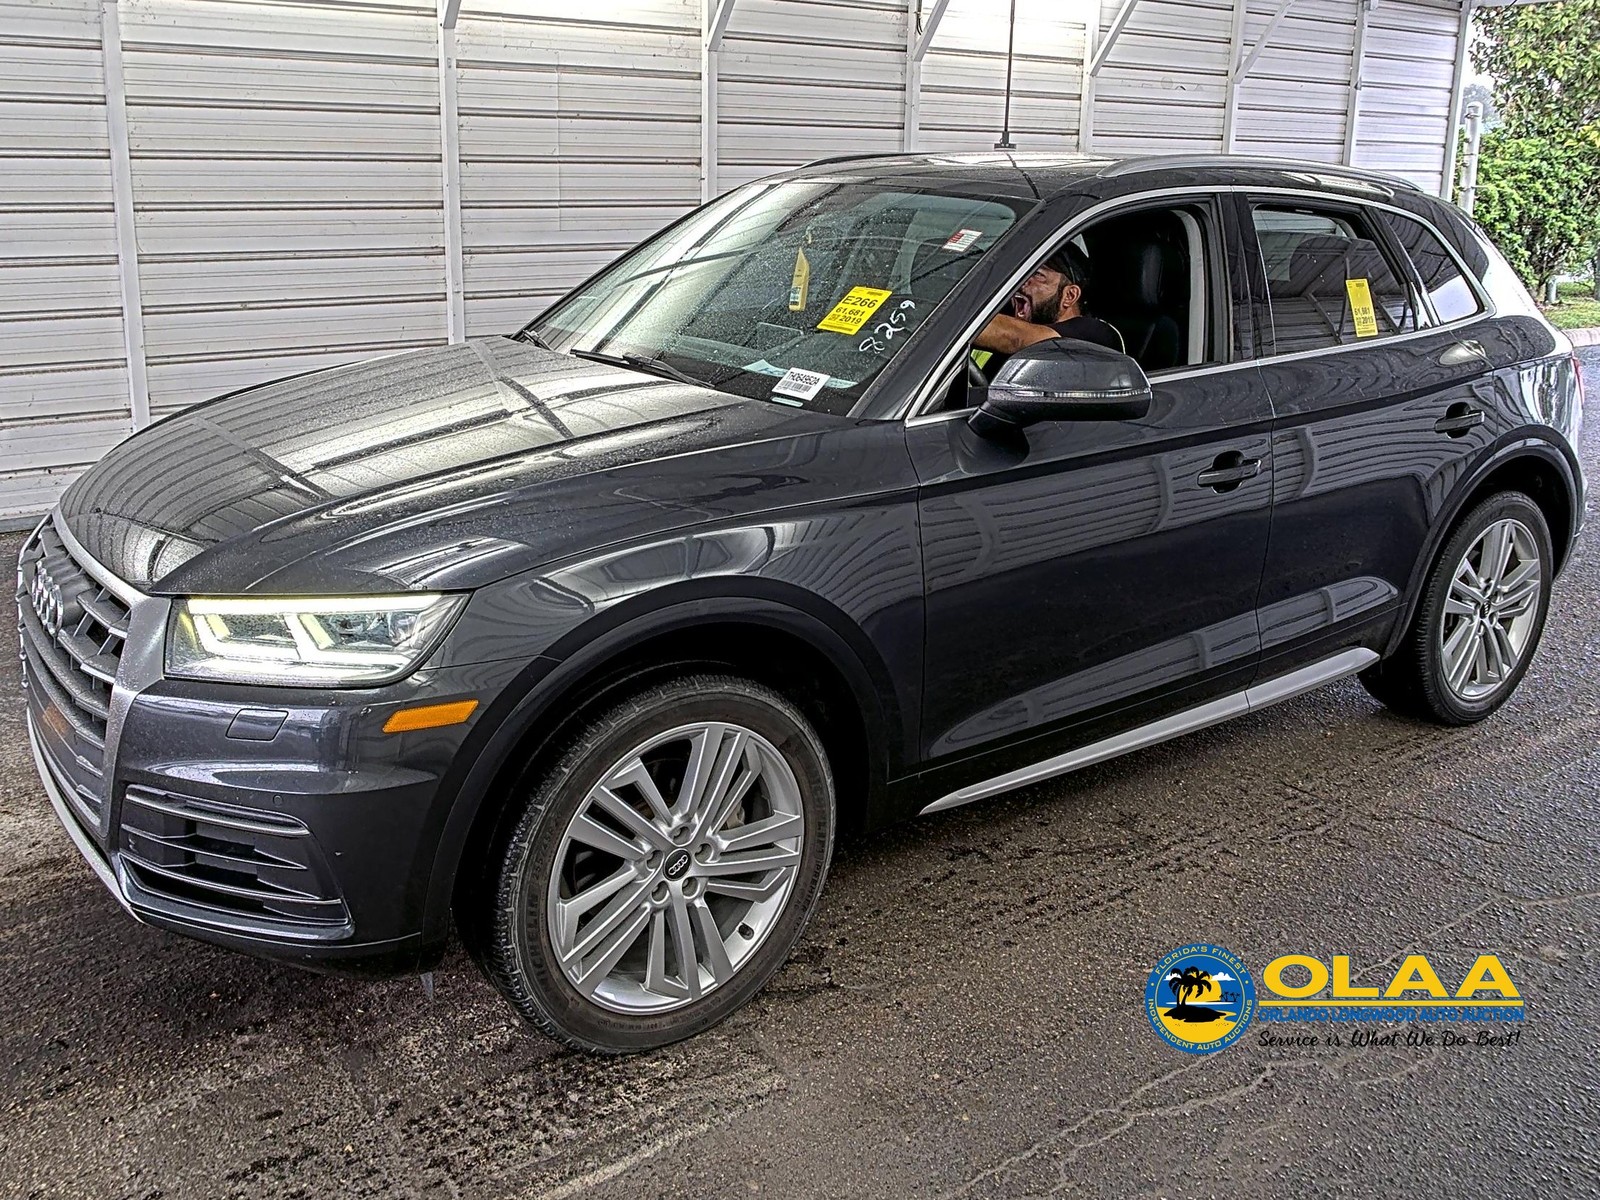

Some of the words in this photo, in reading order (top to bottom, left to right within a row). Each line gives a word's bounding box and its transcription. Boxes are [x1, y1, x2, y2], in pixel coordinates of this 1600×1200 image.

[841, 295, 878, 309] E266
[840, 315, 862, 325] 2019
[859, 300, 916, 354] 8259
